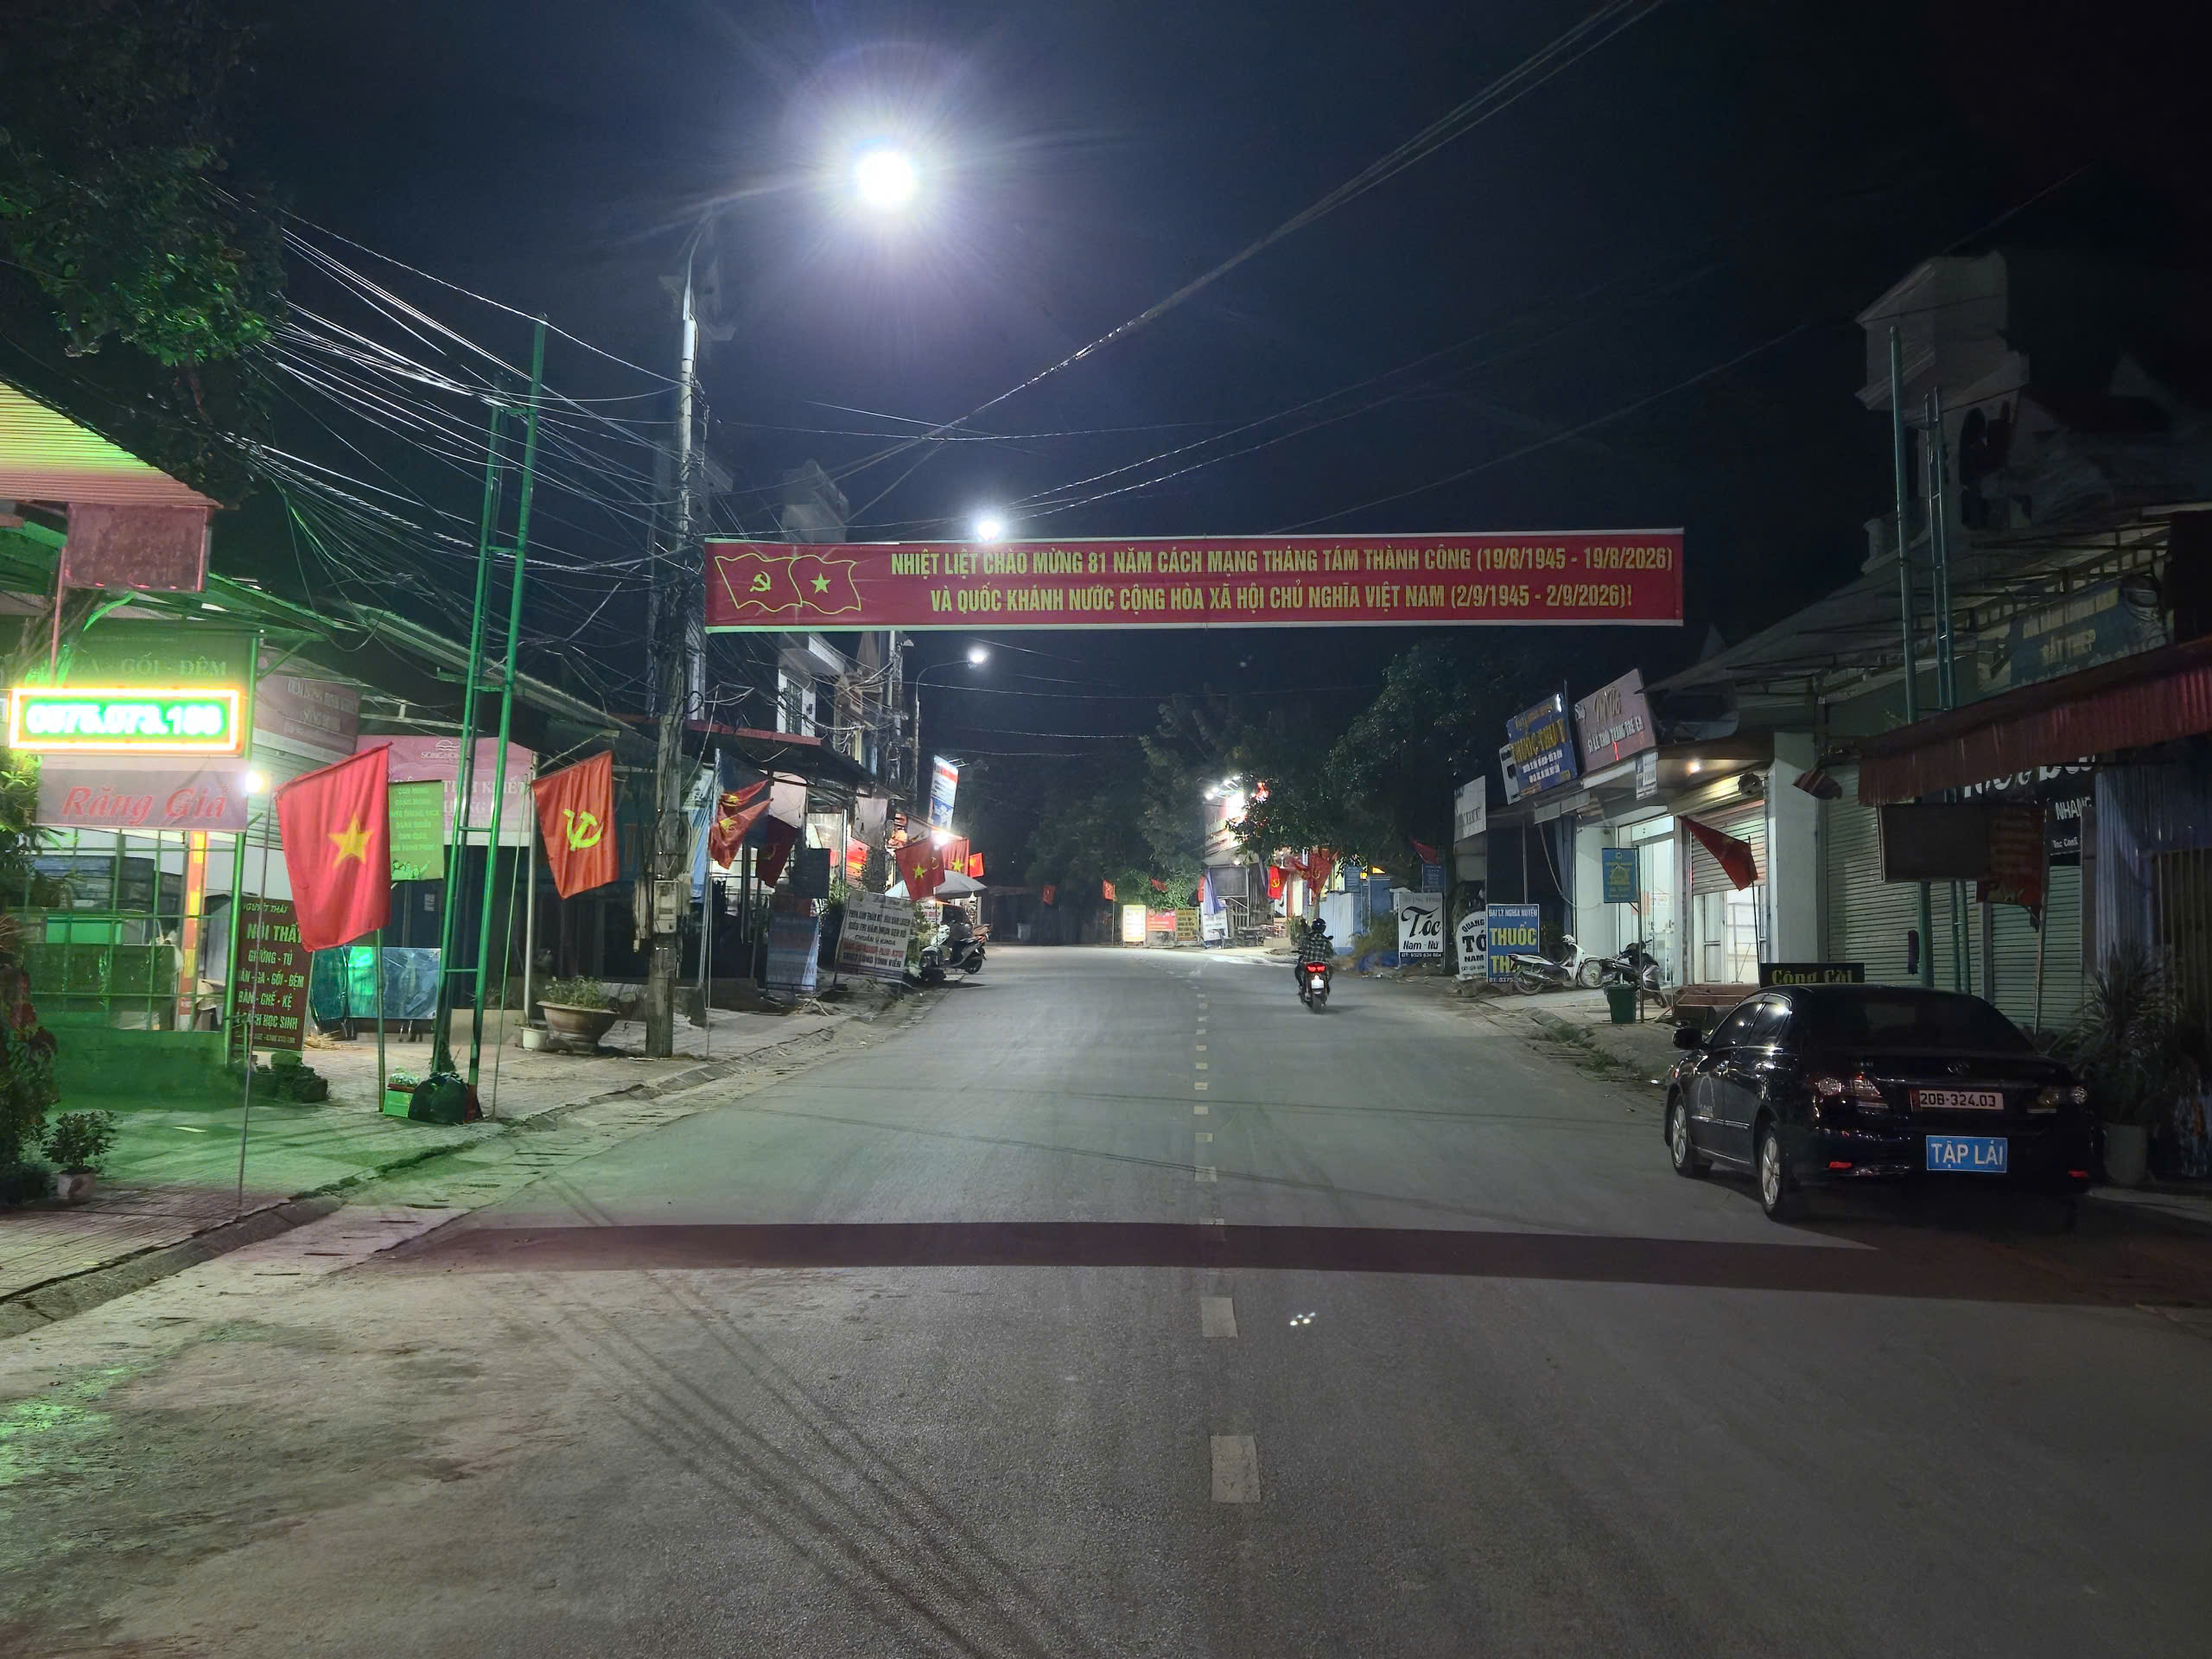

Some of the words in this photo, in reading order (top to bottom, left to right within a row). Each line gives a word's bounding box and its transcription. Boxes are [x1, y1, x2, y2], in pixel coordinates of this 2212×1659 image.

[891, 549, 939, 580] NHIỆT
[944, 548, 977, 580] LIỆT
[983, 548, 1027, 575] CHÀO
[1033, 547, 1083, 575] MỪNG
[1088, 551, 1106, 574] 81
[1113, 546, 1152, 574] NĂM
[1157, 546, 1202, 574] CÁCH
[1208, 550, 1257, 577] MẠNG
[1262, 545, 1318, 572] THÁNG
[1323, 545, 1358, 571] TÁM
[1363, 543, 1419, 570] THÀNH
[1425, 543, 1471, 570] CÔNG
[1584, 546, 1673, 571] 19/8/2026)
[931, 584, 952, 612] VÀ
[957, 582, 1001, 613] QUỐC
[1007, 584, 1064, 612] KHÁNH
[1069, 583, 1115, 611] NƯỚC
[1120, 583, 1166, 615] CỘNG
[1170, 582, 1205, 610] HÒA
[1210, 582, 1231, 609] XÃ
[1236, 582, 1264, 613] HỘI
[1269, 579, 1303, 608] CHỦ
[1308, 582, 1360, 608] NGHĨA
[1365, 581, 1401, 612] VIỆT
[1405, 585, 1445, 608] NAM
[62, 785, 153, 825] Răng
[1401, 906, 1442, 938] Tóc
[1461, 918, 1485, 933] QUANG
[1490, 921, 1537, 946] THUỐC
[1403, 939, 1422, 950] Nam
[1462, 930, 1487, 953] TÓ
[1464, 954, 1484, 963] NAM
[1490, 955, 1512, 975] TH
[279, 1015, 298, 1030] SINH
[1930, 1141, 1969, 1169] TẬP
[1974, 1139, 2004, 1166] LÁI
